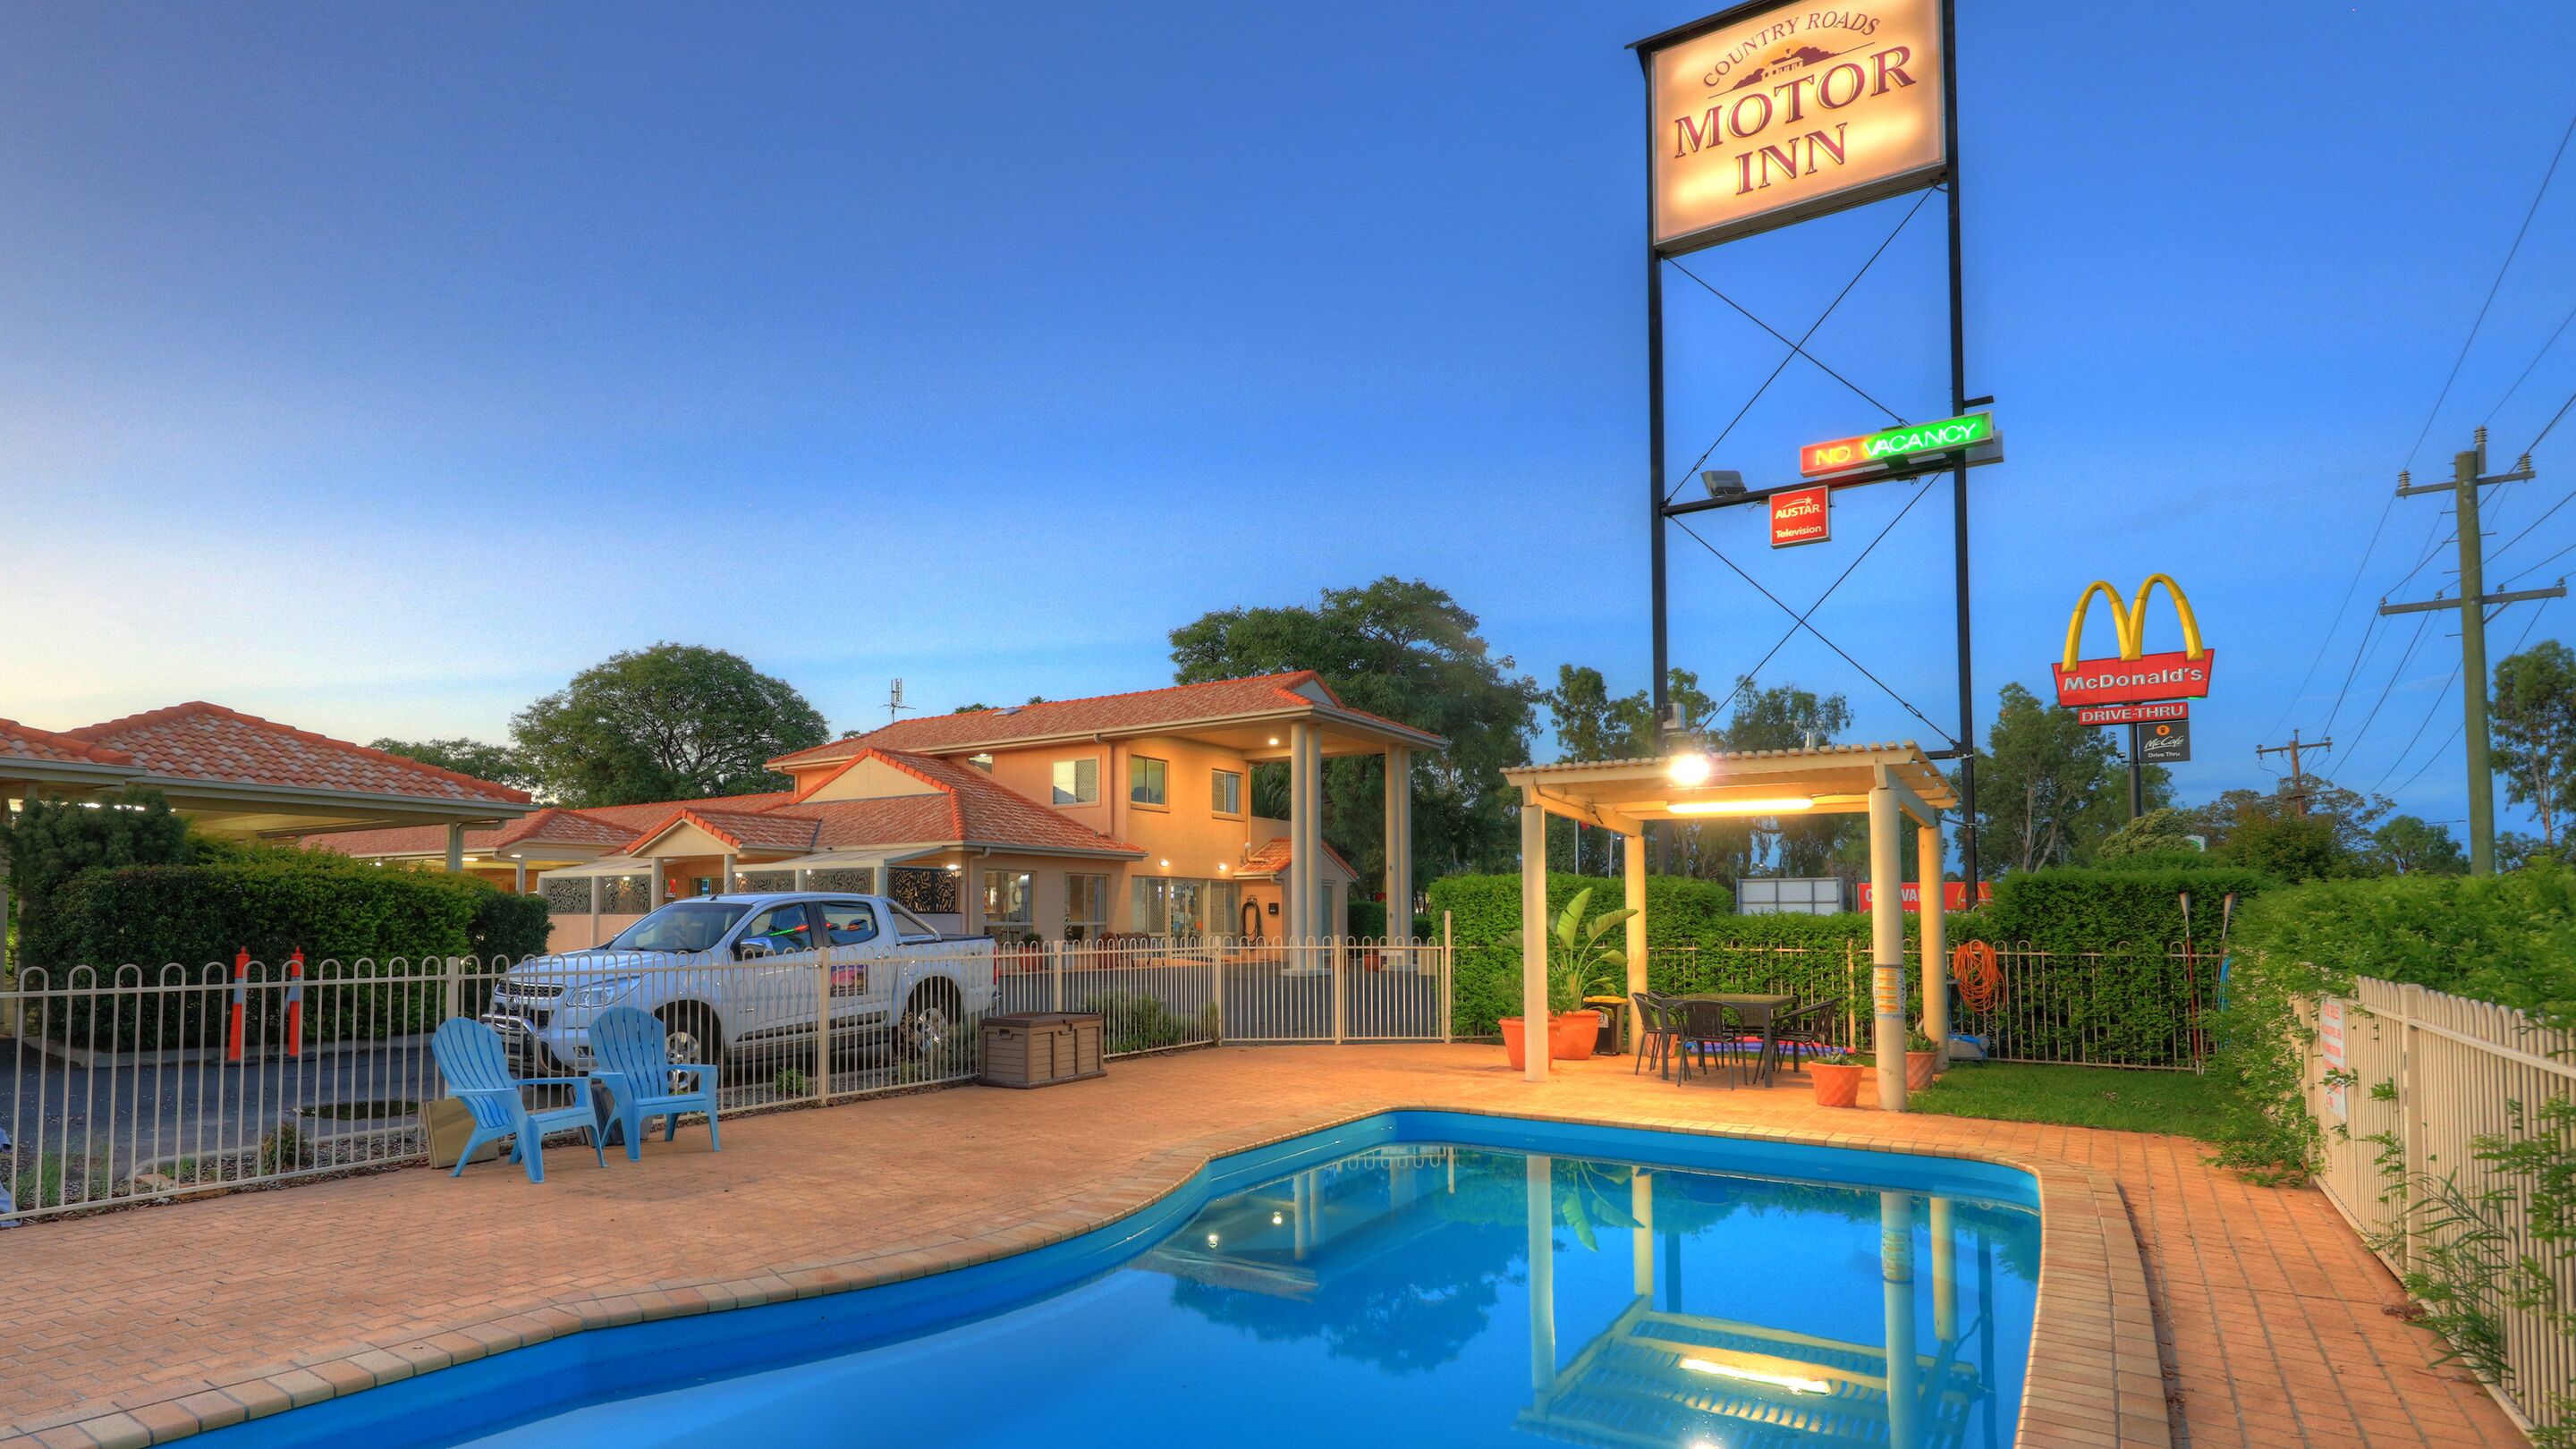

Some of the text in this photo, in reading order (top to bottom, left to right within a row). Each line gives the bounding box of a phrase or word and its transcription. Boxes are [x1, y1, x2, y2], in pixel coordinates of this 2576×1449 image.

[1703, 11, 1881, 88] COUNTRY ROADS
[1674, 46, 1916, 159] MOTOR
[1735, 122, 1848, 196] INN
[1815, 422, 1977, 466] NO VACANCY
[1775, 504, 1820, 520] AUSTAR
[1775, 525, 1822, 538] Television
[2063, 667, 2203, 691] McDonald's
[2081, 705, 2184, 723] DRIVE-THRU
